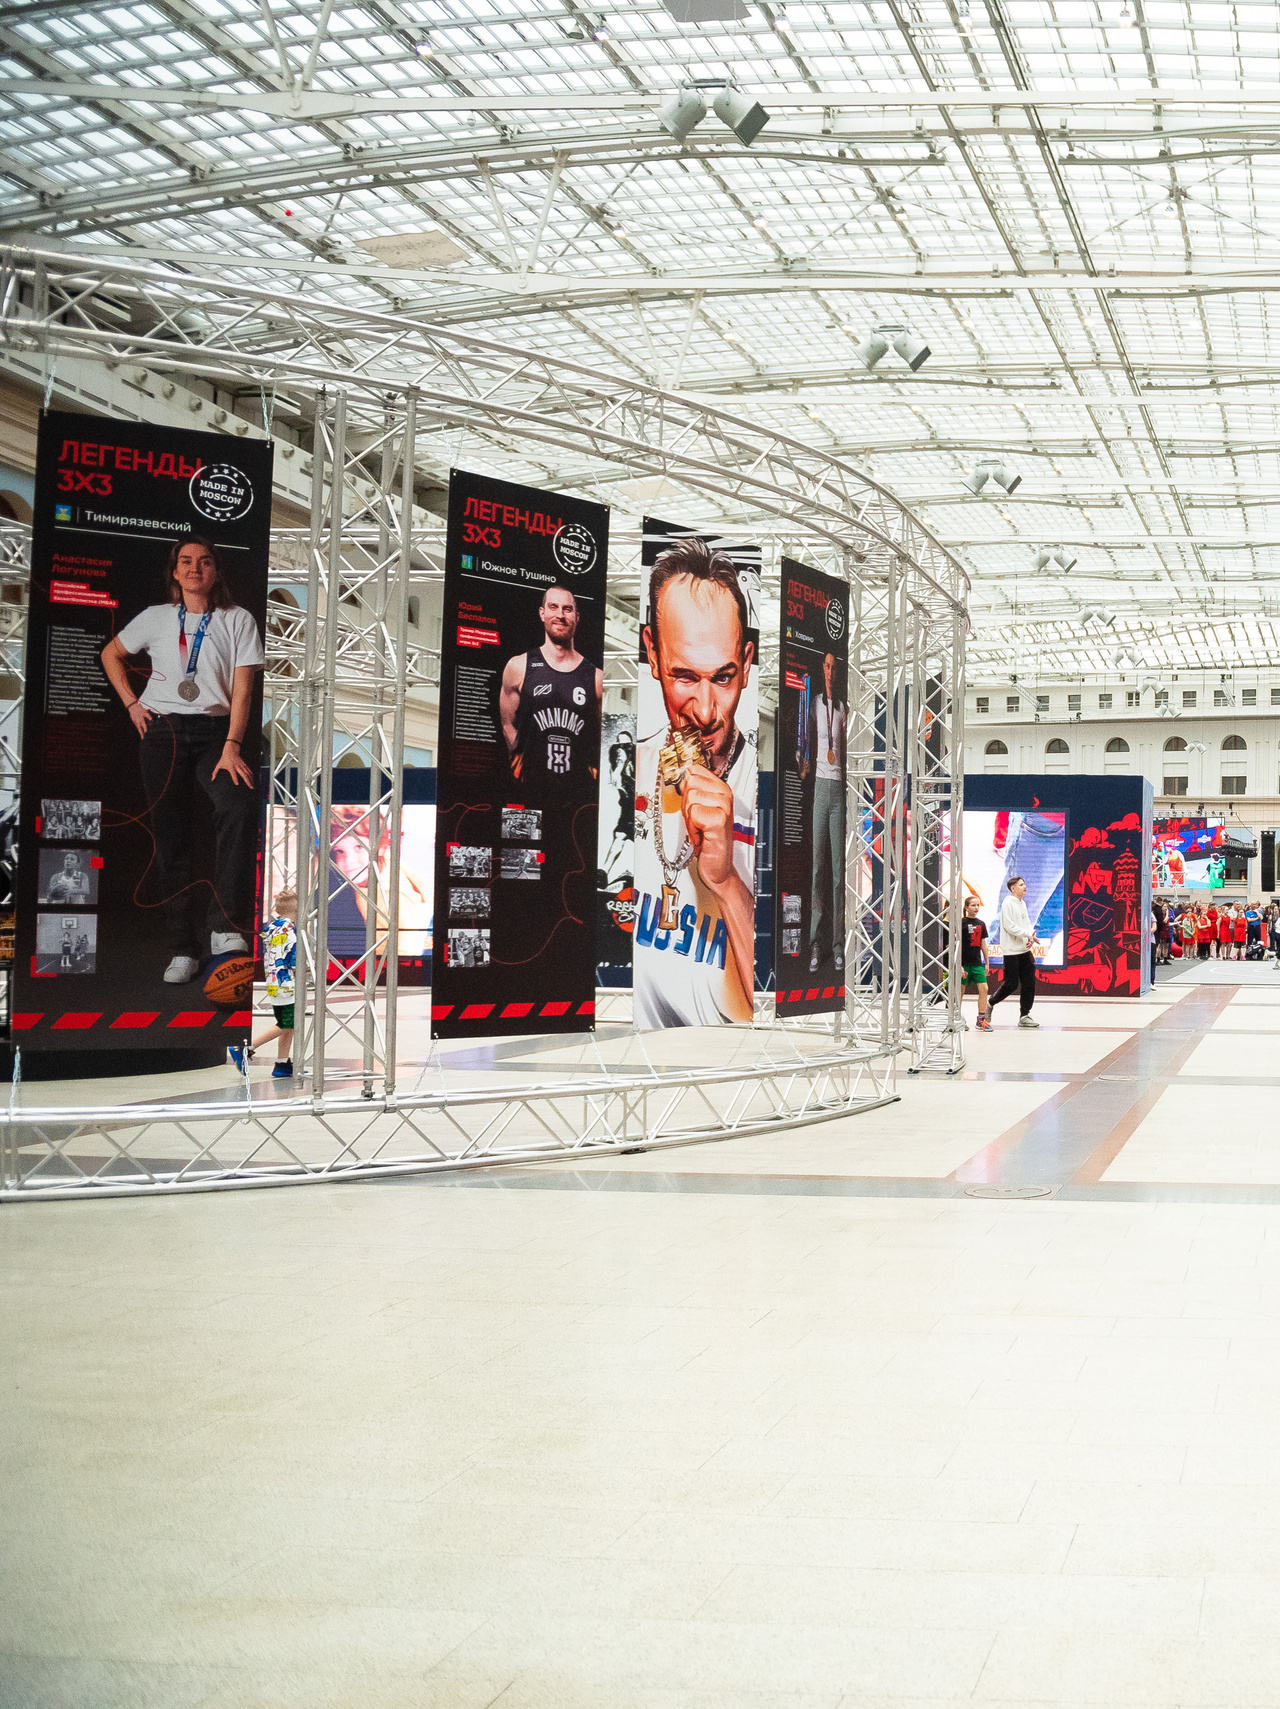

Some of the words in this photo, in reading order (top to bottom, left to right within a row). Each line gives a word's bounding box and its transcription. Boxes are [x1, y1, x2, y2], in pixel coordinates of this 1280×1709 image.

[58, 440, 202, 479] ЛЕГЕНДЫ
[200, 480, 228, 492] MADE
[231, 486, 245, 496] IN
[200, 490, 242, 505] MOSCOW
[85, 510, 192, 532] Тимирязевский
[464, 497, 562, 537] ЛЕГЕНДЫ
[560, 537, 580, 549] MADE
[581, 544, 591, 553] IN
[560, 546, 589, 561] MOSCOW
[52, 553, 113, 567] Анастасия
[51, 564, 107, 577] Логунова
[481, 561, 518, 576] Южное
[520, 567, 557, 584] Тушино
[573, 687, 587, 706] 6
[215, 961, 254, 982] Wilso
